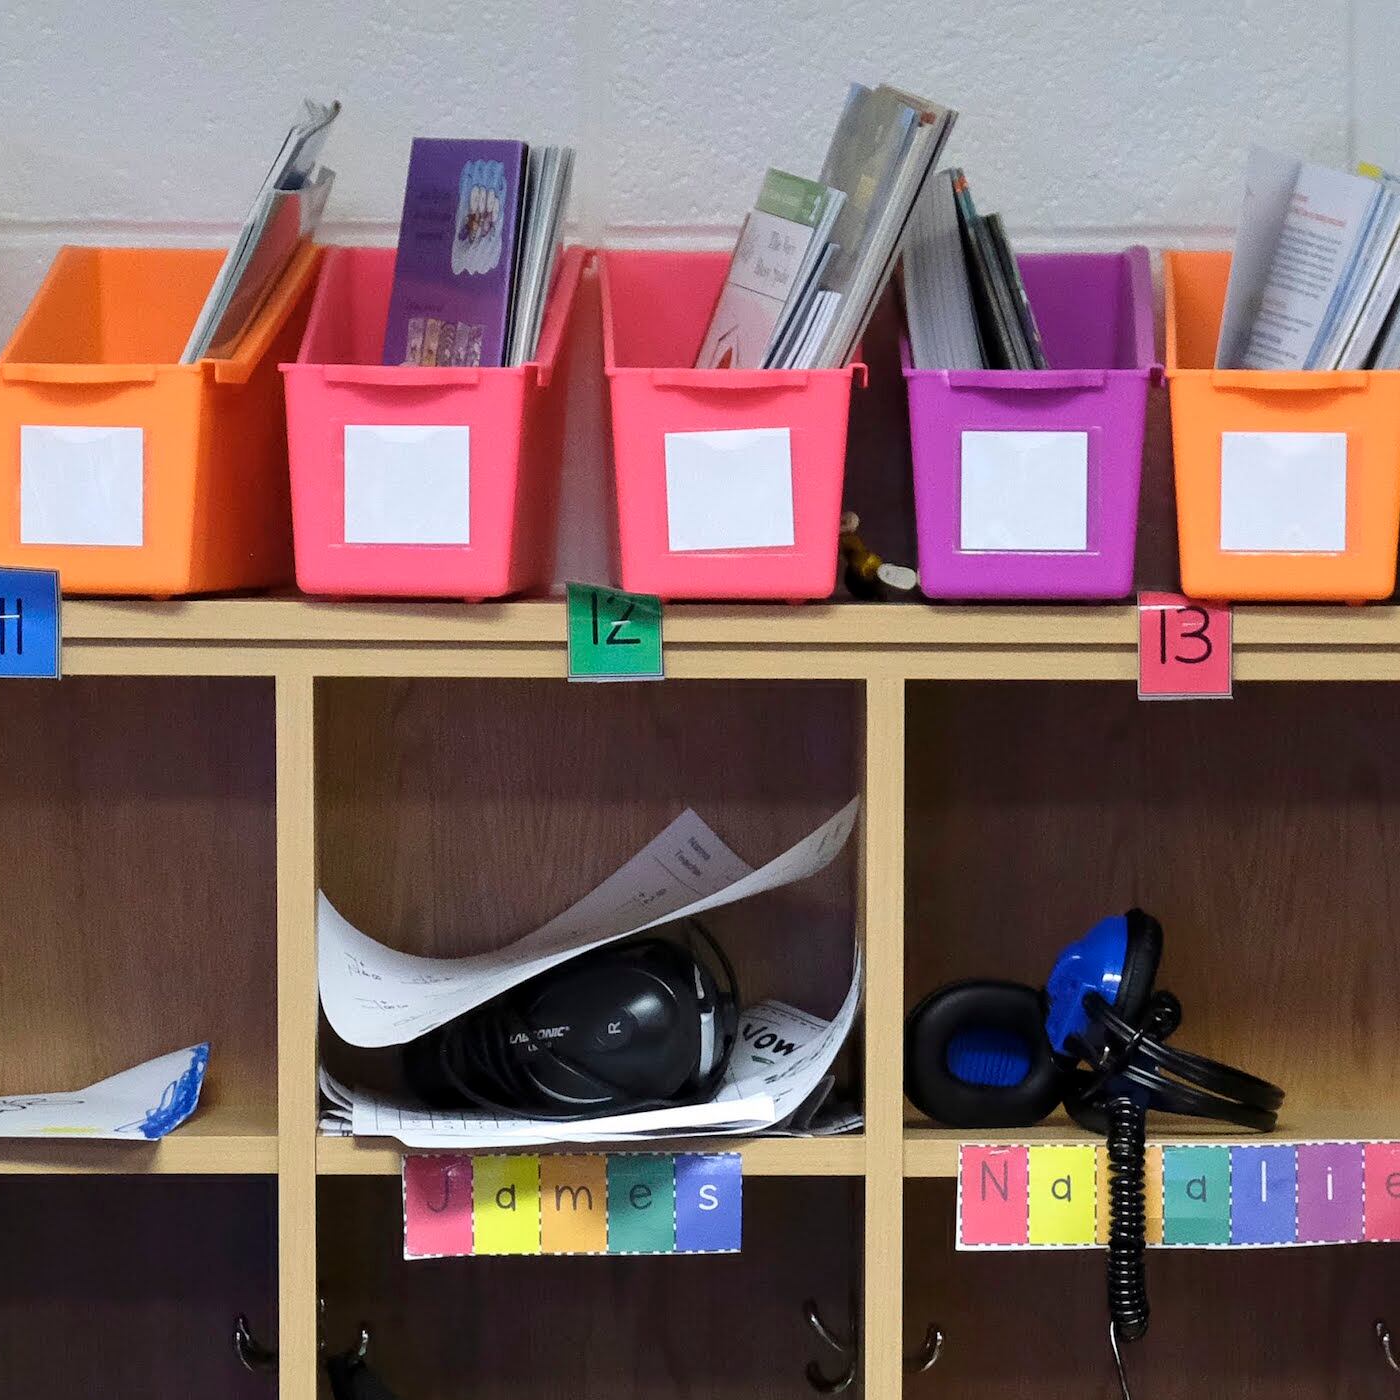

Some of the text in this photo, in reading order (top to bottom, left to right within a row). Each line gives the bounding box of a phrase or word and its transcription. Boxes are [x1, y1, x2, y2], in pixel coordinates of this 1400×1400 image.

[591, 591, 642, 646] 12
[1160, 605, 1213, 665] 13
[607, 1020, 622, 1035] R
[426, 1170, 720, 1214] James
